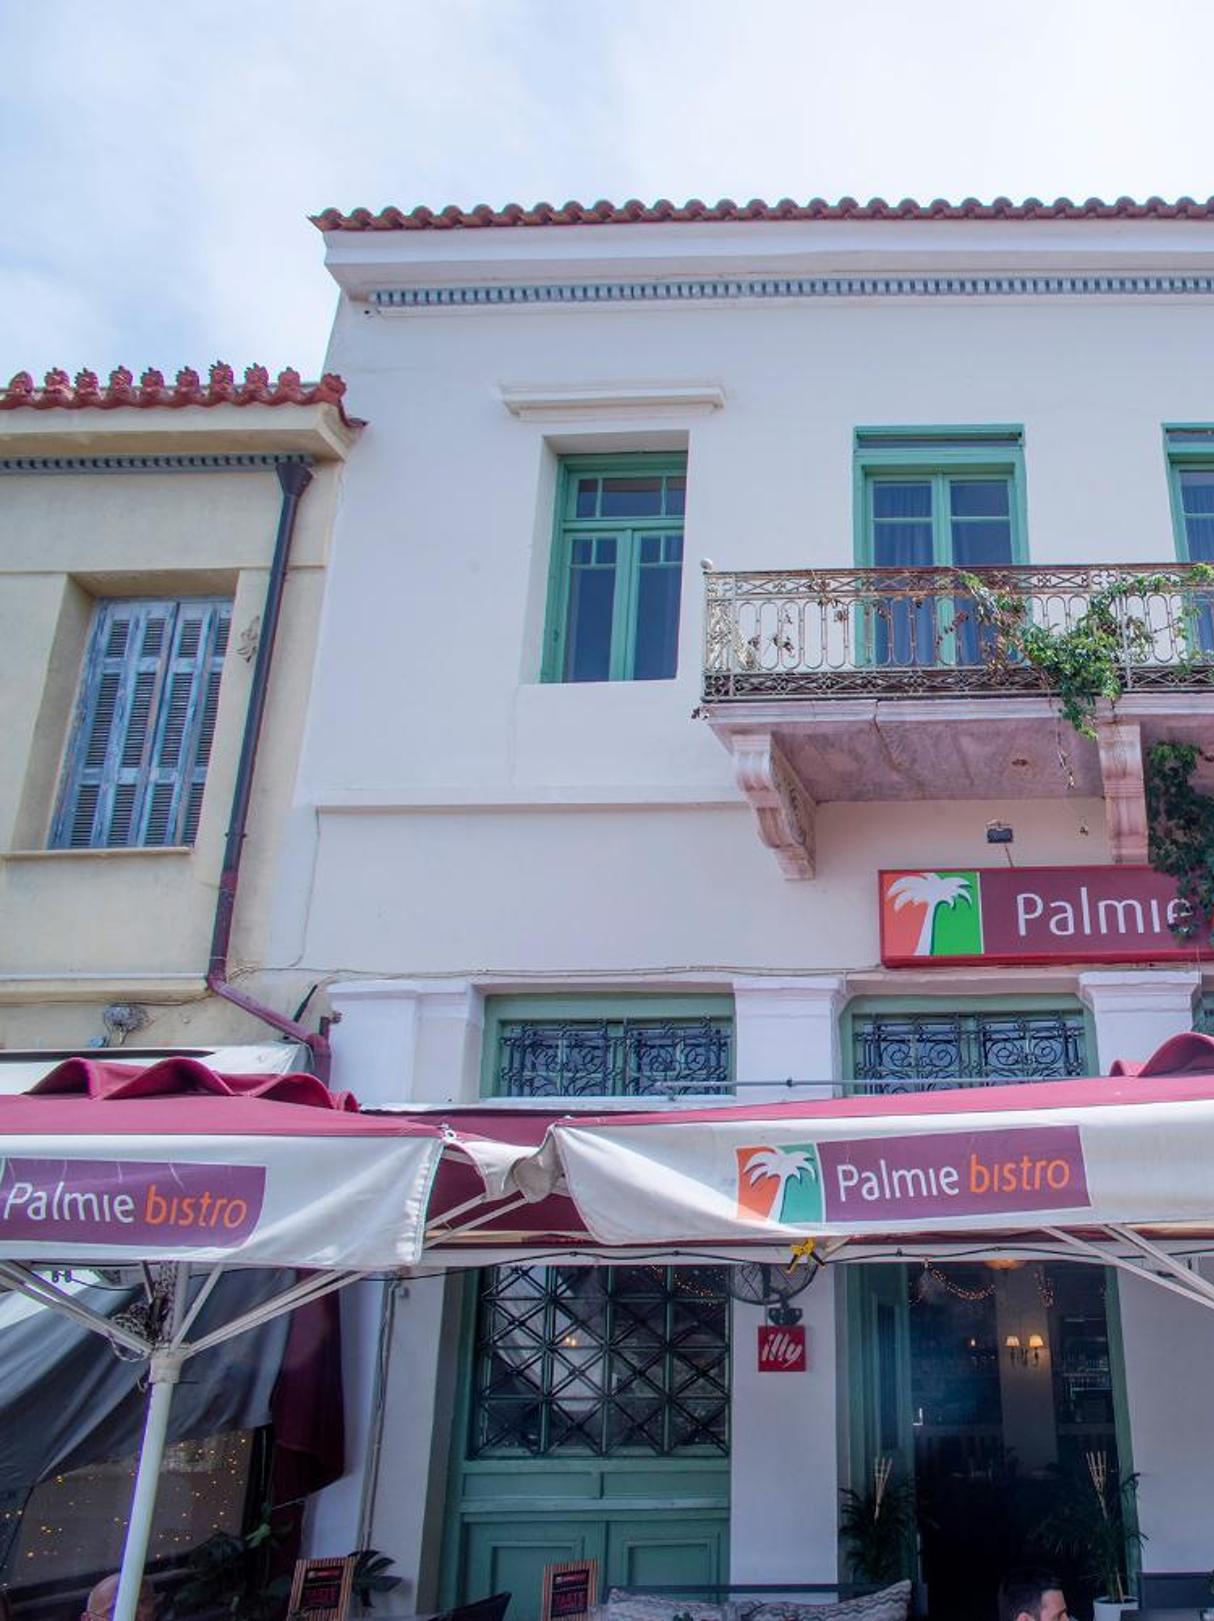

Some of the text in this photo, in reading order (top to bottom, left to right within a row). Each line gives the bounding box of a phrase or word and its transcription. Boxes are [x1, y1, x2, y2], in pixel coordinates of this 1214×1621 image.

[1016, 887, 1192, 935] Palmie
[837, 1154, 1069, 1201] Palmie bistro
[4, 1181, 247, 1228] Palmie bistro
[761, 1333, 802, 1368] illy
